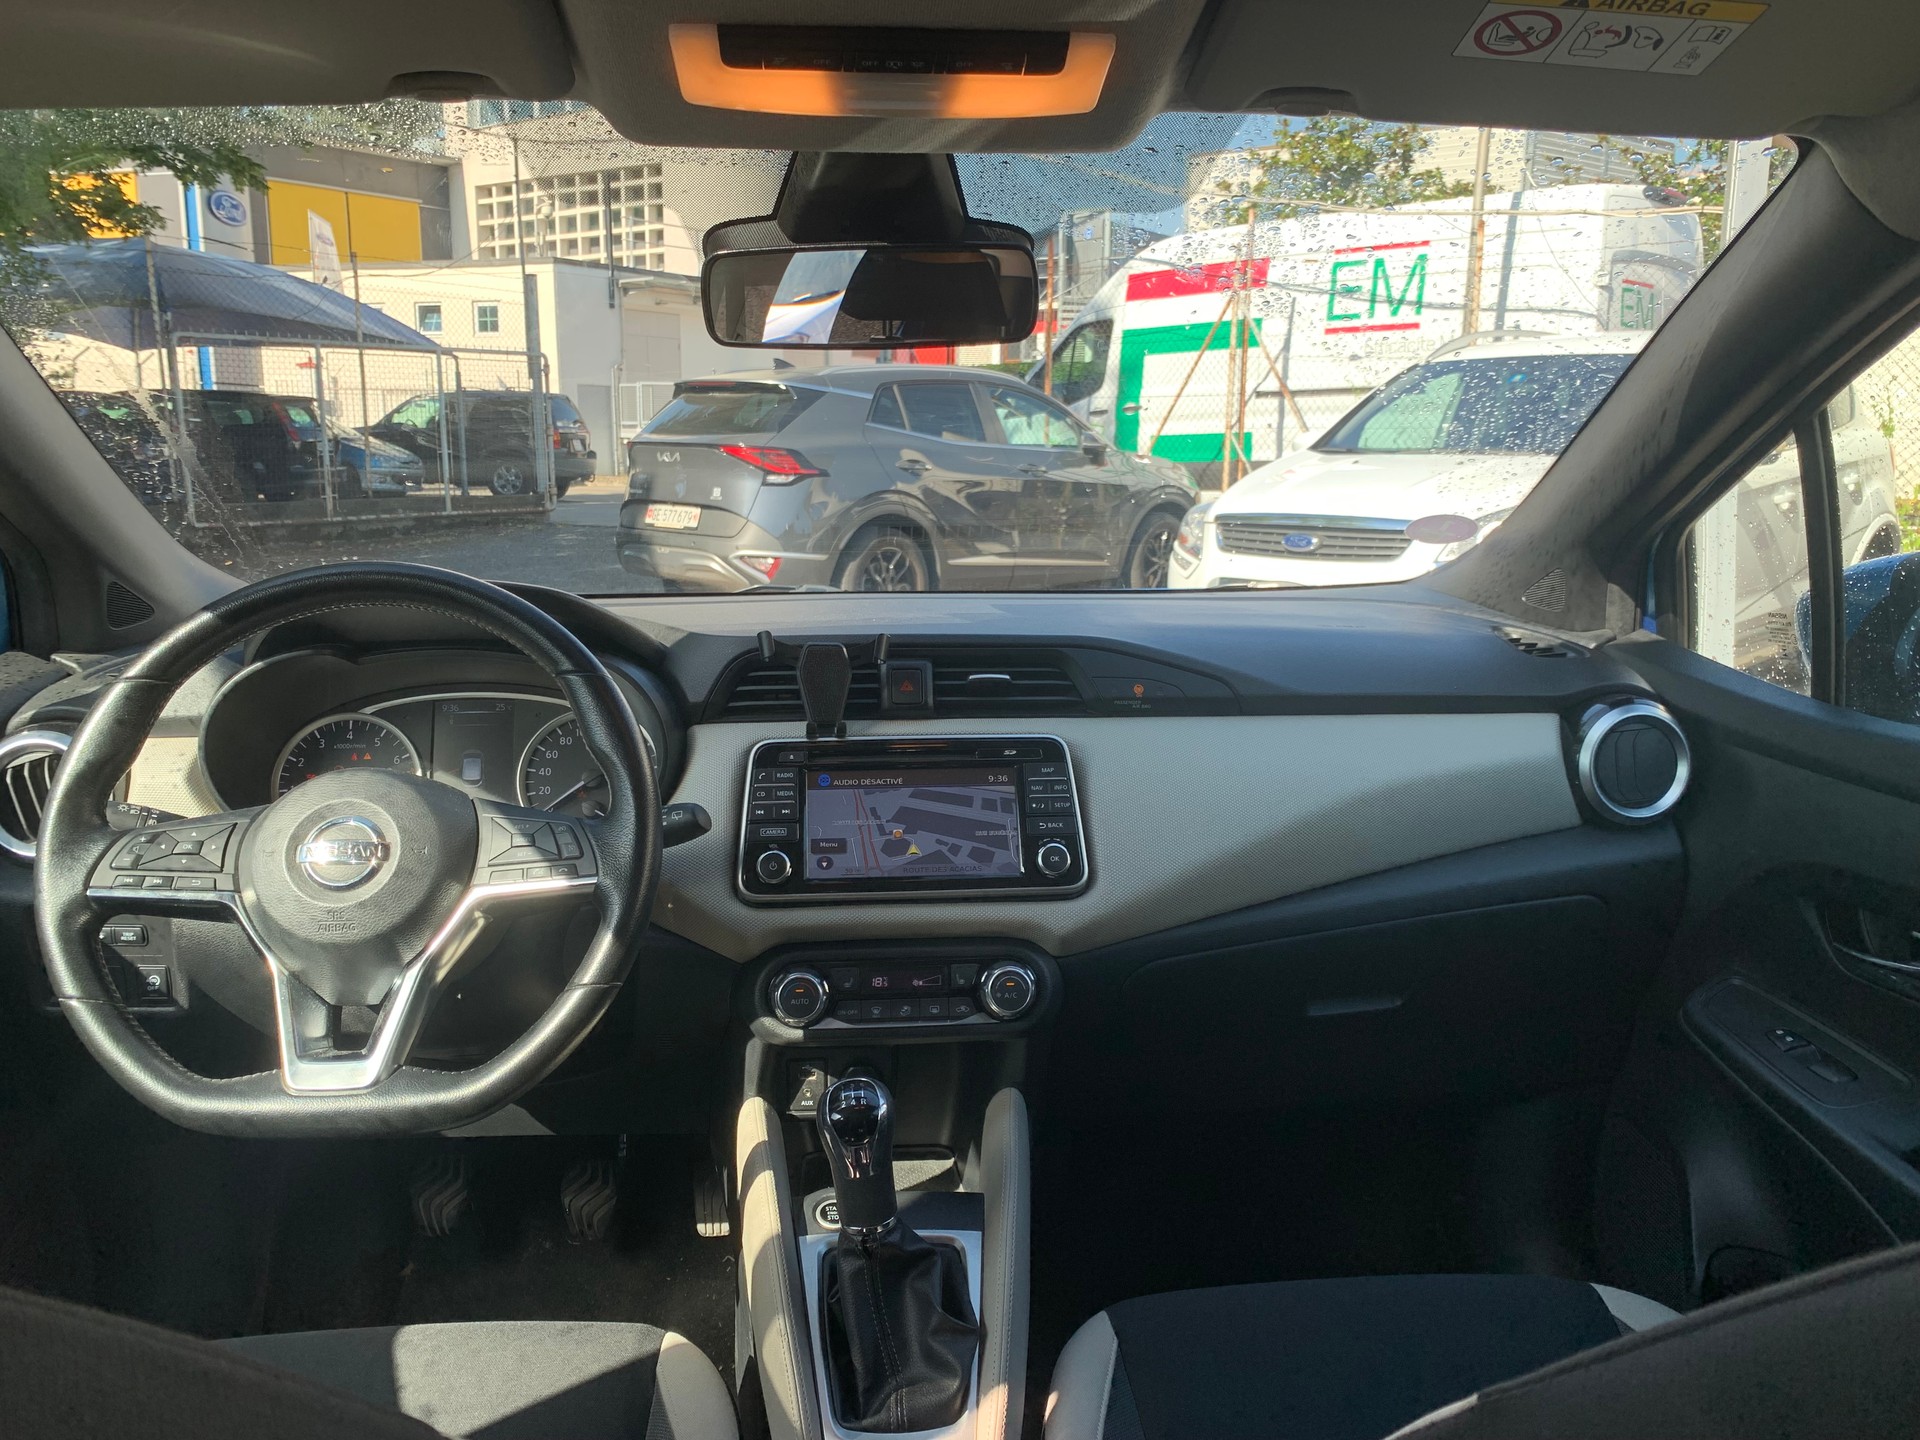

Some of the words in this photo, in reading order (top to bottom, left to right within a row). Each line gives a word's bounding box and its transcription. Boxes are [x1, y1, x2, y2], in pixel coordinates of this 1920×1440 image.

[1595, 0, 1711, 16] AIRBAG
[1326, 253, 1428, 321] EM
[1621, 287, 1654, 330] EM
[441, 704, 459, 712] 9:36
[346, 731, 353, 740] 4
[319, 739, 325, 748] 3
[374, 738, 380, 747] 5
[559, 737, 573, 745] 80
[393, 755, 400, 764] 6
[545, 751, 558, 759] 60
[297, 758, 304, 767] 2
[538, 768, 552, 776] 40
[988, 774, 1008, 782] 9:36
[538, 786, 551, 795] 20
[304, 843, 382, 860] NSSAN
[950, 865, 982, 873] ACACIAS
[316, 922, 357, 933] AIRBAG
